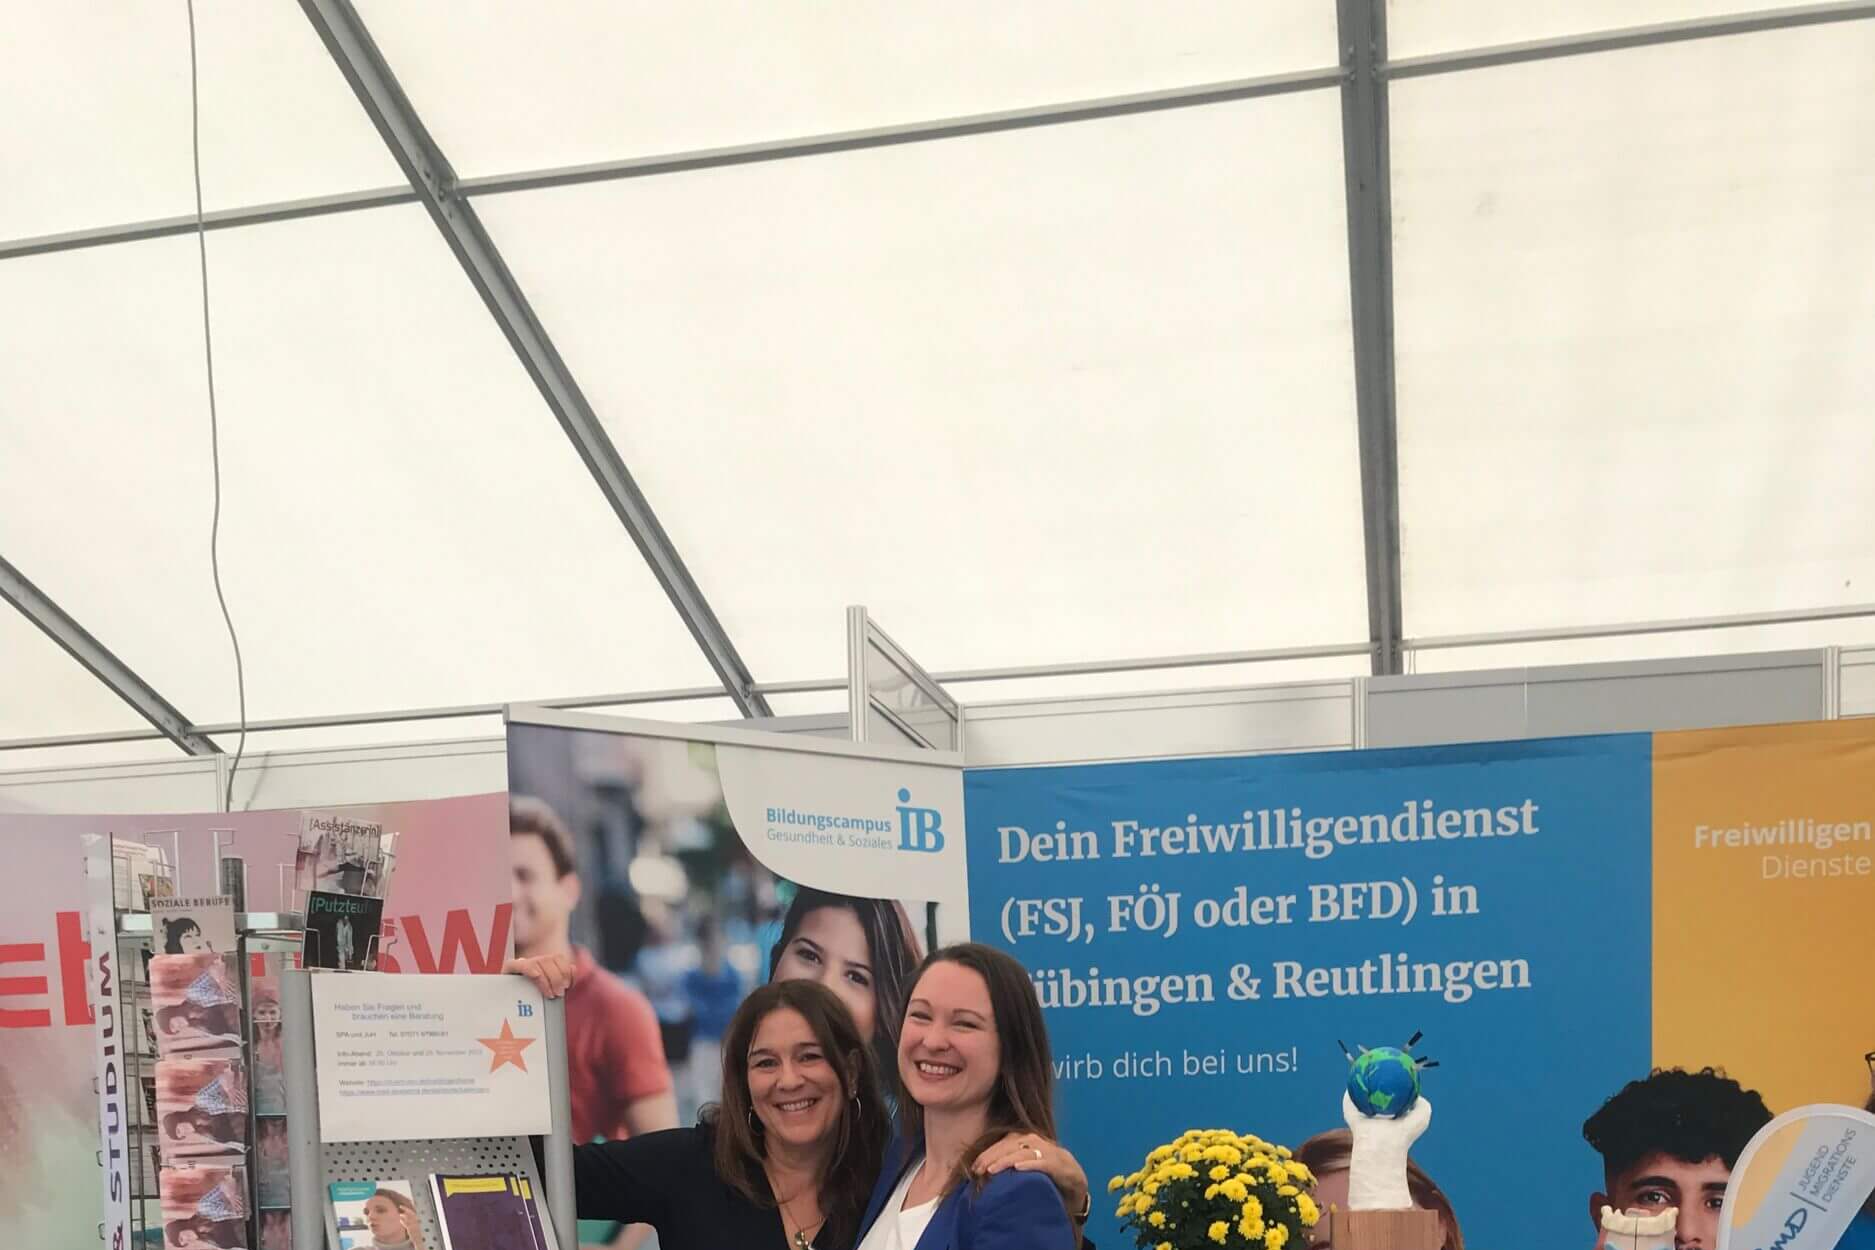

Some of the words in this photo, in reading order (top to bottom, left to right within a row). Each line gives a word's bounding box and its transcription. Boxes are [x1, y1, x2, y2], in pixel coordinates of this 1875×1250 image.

[766, 808, 892, 834] Bildungscampus
[767, 828, 833, 846] Gesundheit
[837, 834, 846, 846] &
[849, 835, 893, 850] Soziales
[998, 821, 1101, 864] Dein
[1111, 799, 1539, 859] Freiwilligendienst
[1695, 818, 1871, 849] Freiwilligen
[1762, 854, 1871, 879] Dienste
[151, 899, 191, 908] SOZIALE
[1000, 896, 1095, 944] (FSJ,
[1107, 884, 1181, 938] FÖJ
[1193, 886, 1297, 928] oder
[1308, 877, 1418, 926] BFD)
[1432, 875, 1479, 917] in
[1028, 967, 1216, 1017] übingen
[1227, 963, 1261, 1001] &
[1273, 953, 1532, 1003] Reutlingen
[99, 951, 122, 1204] STUDIUM
[1113, 1050, 1172, 1079] dich
[1183, 1048, 1226, 1076] bei
[1237, 1046, 1298, 1073] uns!
[1798, 1145, 1829, 1192] JUGEND
[1809, 1128, 1857, 1197] MIGRATIONS
[1822, 1156, 1857, 1203] DIENSTE
